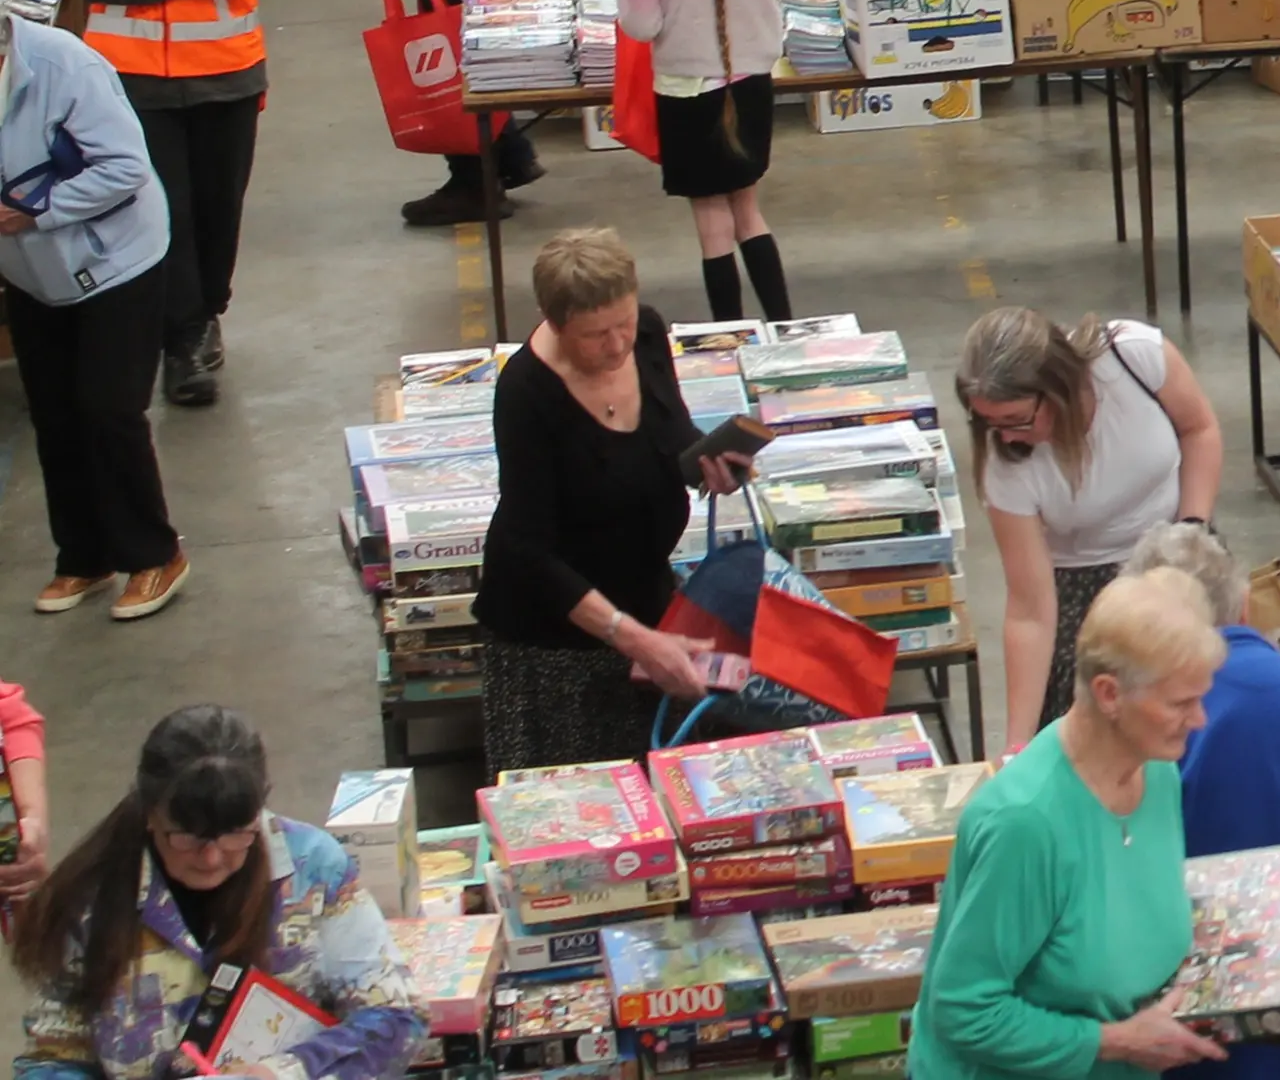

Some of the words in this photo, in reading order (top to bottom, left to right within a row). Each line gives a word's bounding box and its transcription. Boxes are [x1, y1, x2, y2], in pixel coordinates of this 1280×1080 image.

[414, 537, 485, 560] Grand
[690, 837, 734, 853] 1000
[712, 863, 758, 880] 1000
[553, 930, 597, 953] 1000
[645, 984, 725, 1019] 1000
[824, 988, 875, 1008] 500
